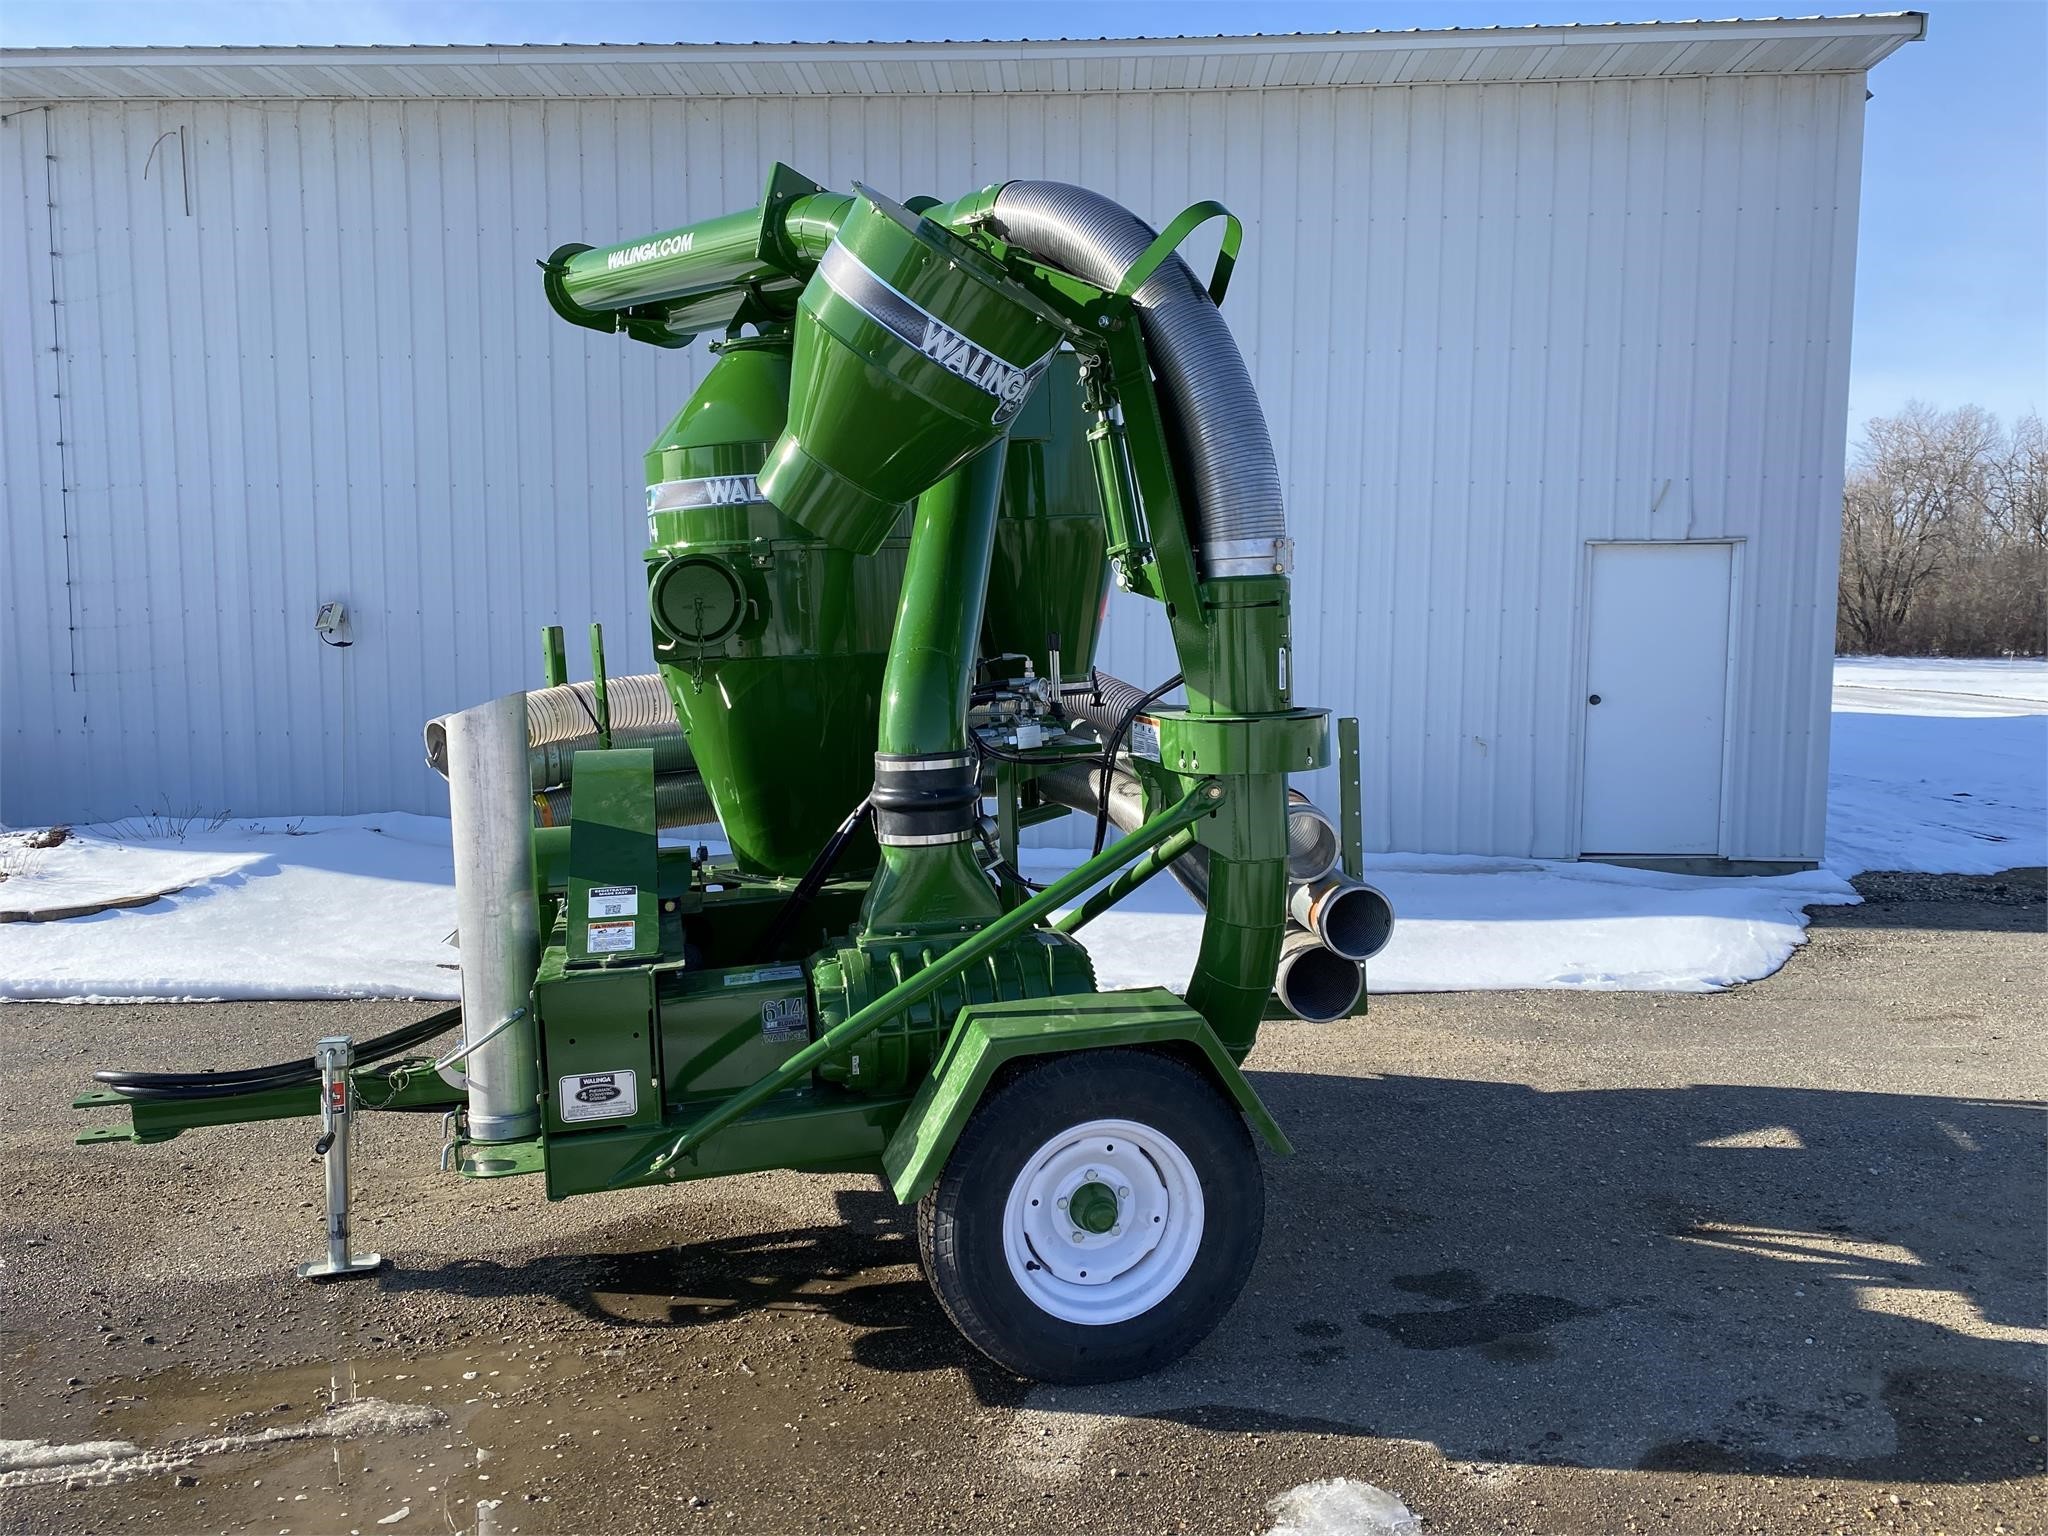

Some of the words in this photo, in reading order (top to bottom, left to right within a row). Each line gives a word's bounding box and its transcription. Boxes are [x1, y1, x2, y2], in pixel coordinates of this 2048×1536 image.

[607, 232, 695, 270] WALINGA.COM
[704, 478, 768, 505] WAL
[762, 998, 804, 1024] 614
[583, 1077, 611, 1085] WALINGA
